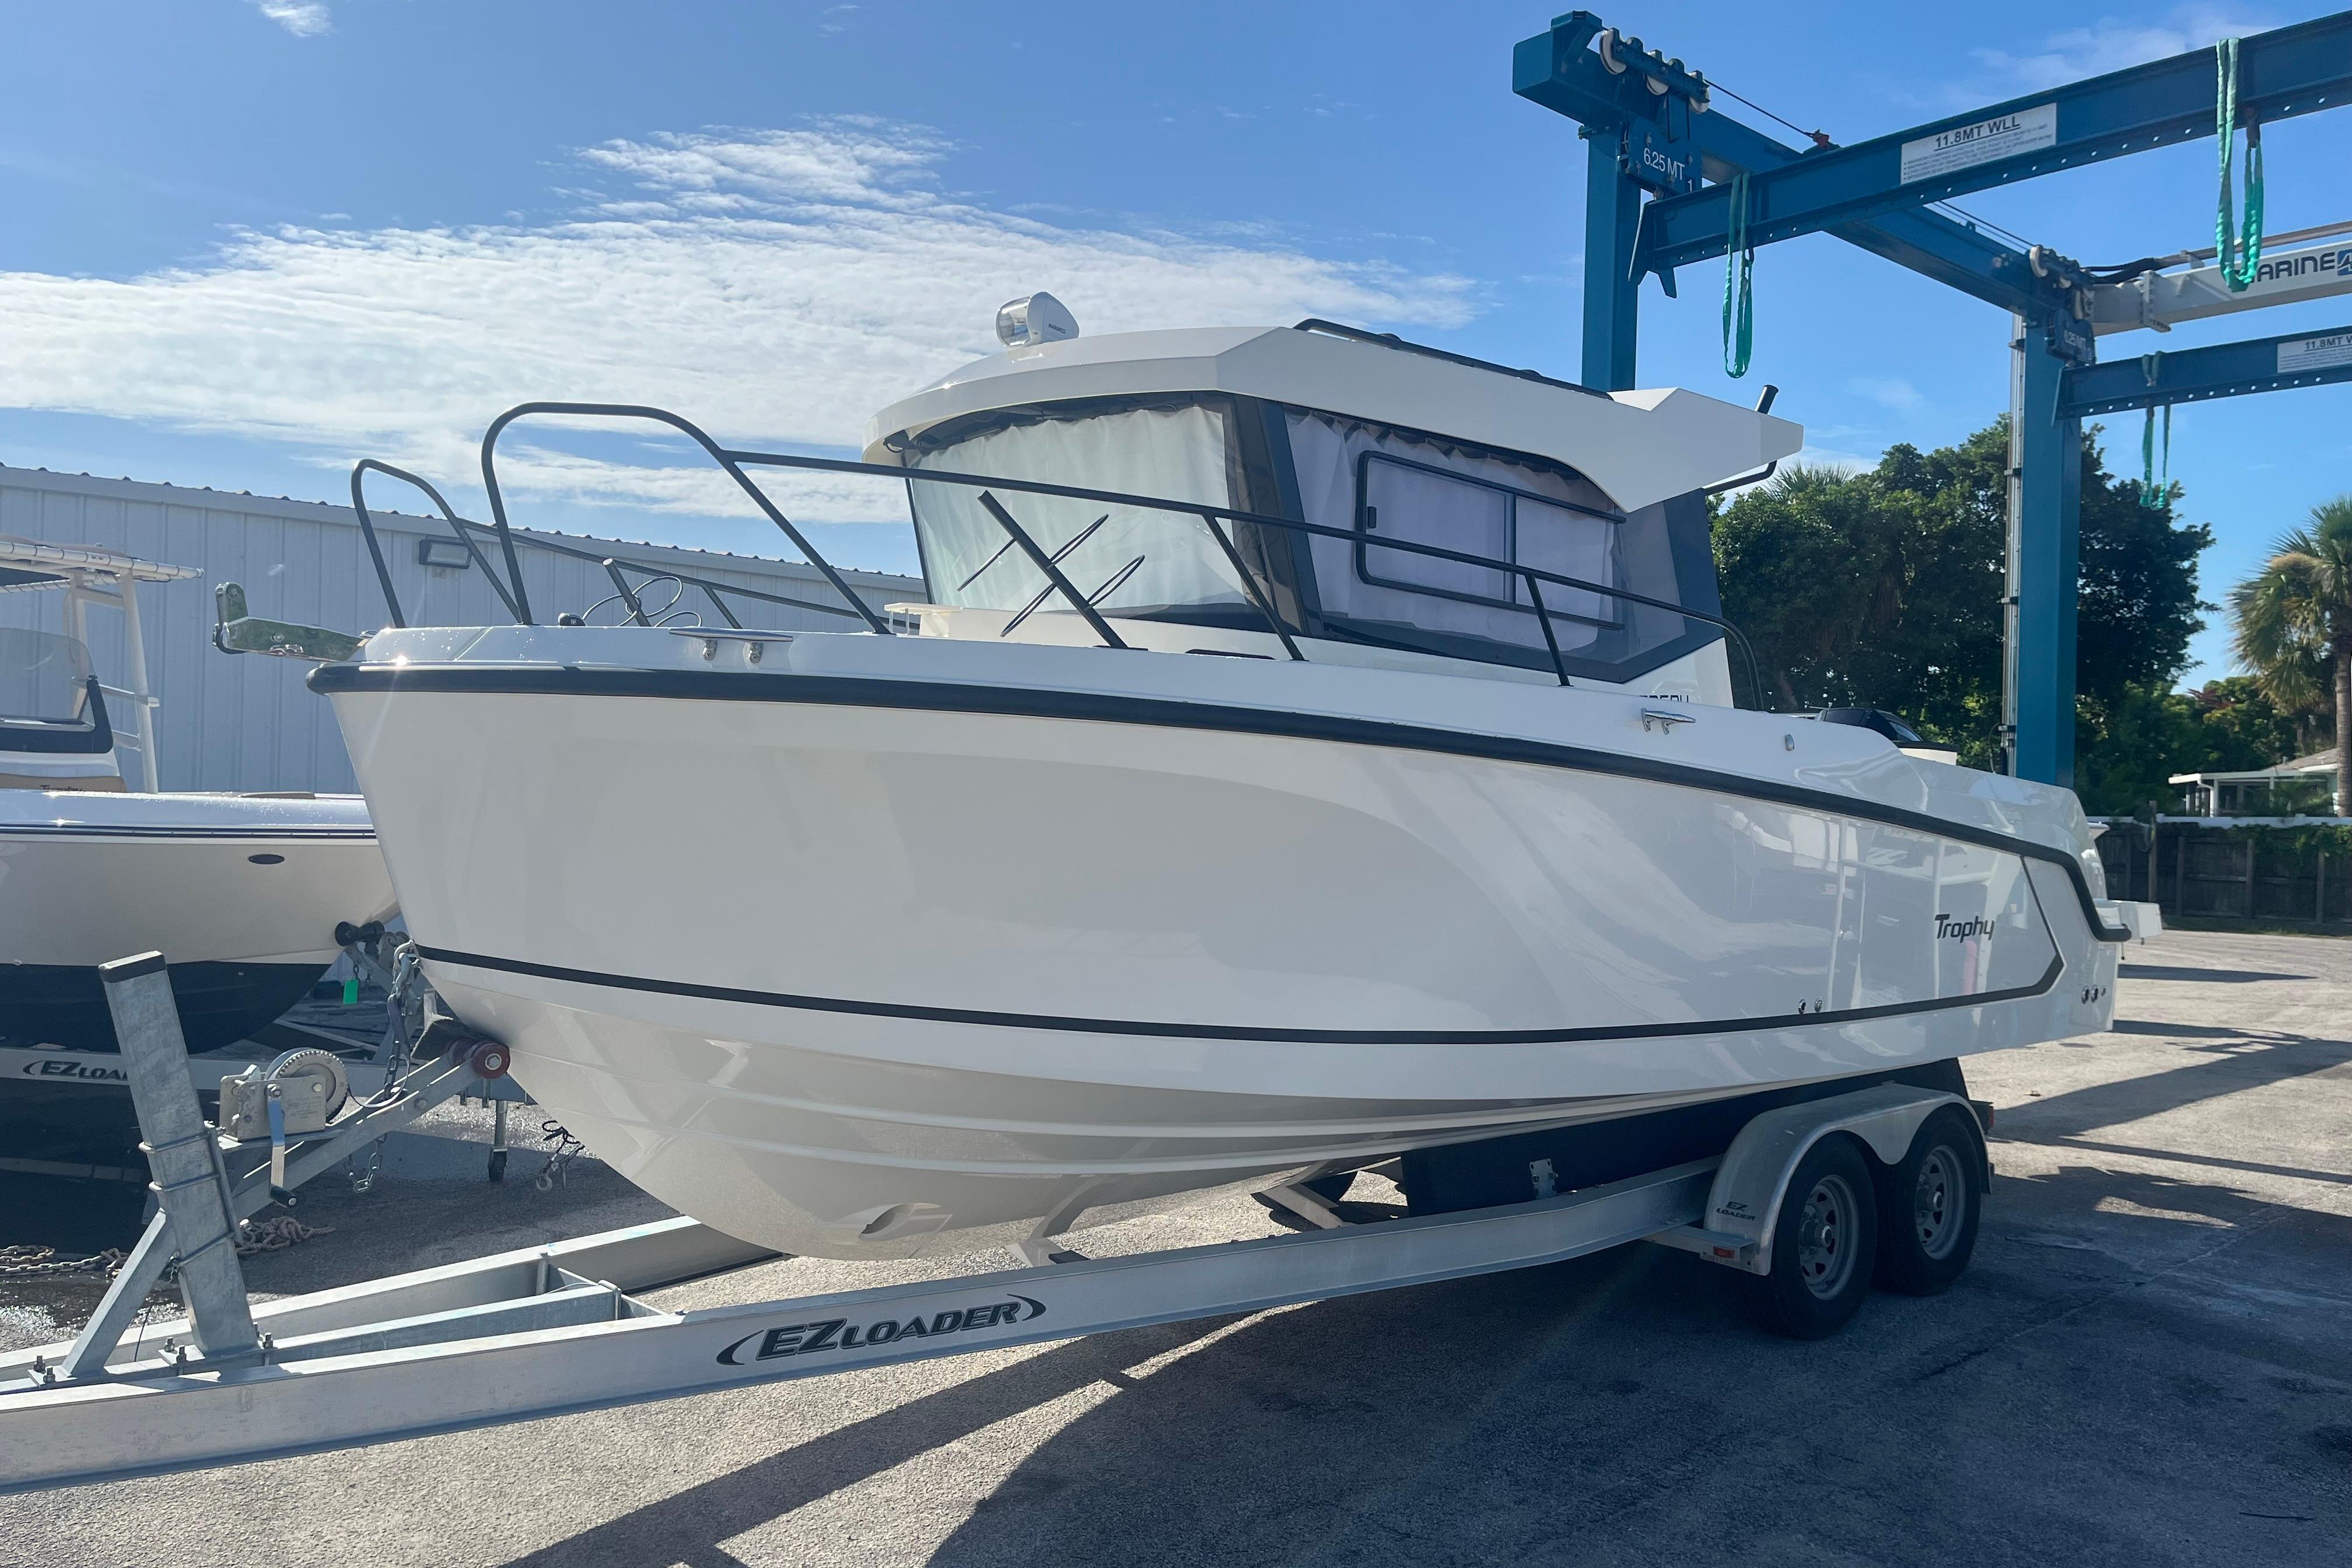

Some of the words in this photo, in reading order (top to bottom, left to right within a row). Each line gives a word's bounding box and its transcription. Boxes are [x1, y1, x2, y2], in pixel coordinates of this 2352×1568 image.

[1936, 122, 1983, 148] 11.8MT
[1988, 117, 2020, 133] WLL
[1644, 148, 1665, 172] 6.25
[1668, 157, 1685, 180] MT
[2235, 252, 2335, 282] ARINE
[1934, 914, 1995, 943] Trophy
[1716, 1208, 1756, 1221] LOADER
[1726, 1201, 1748, 1212] EZ
